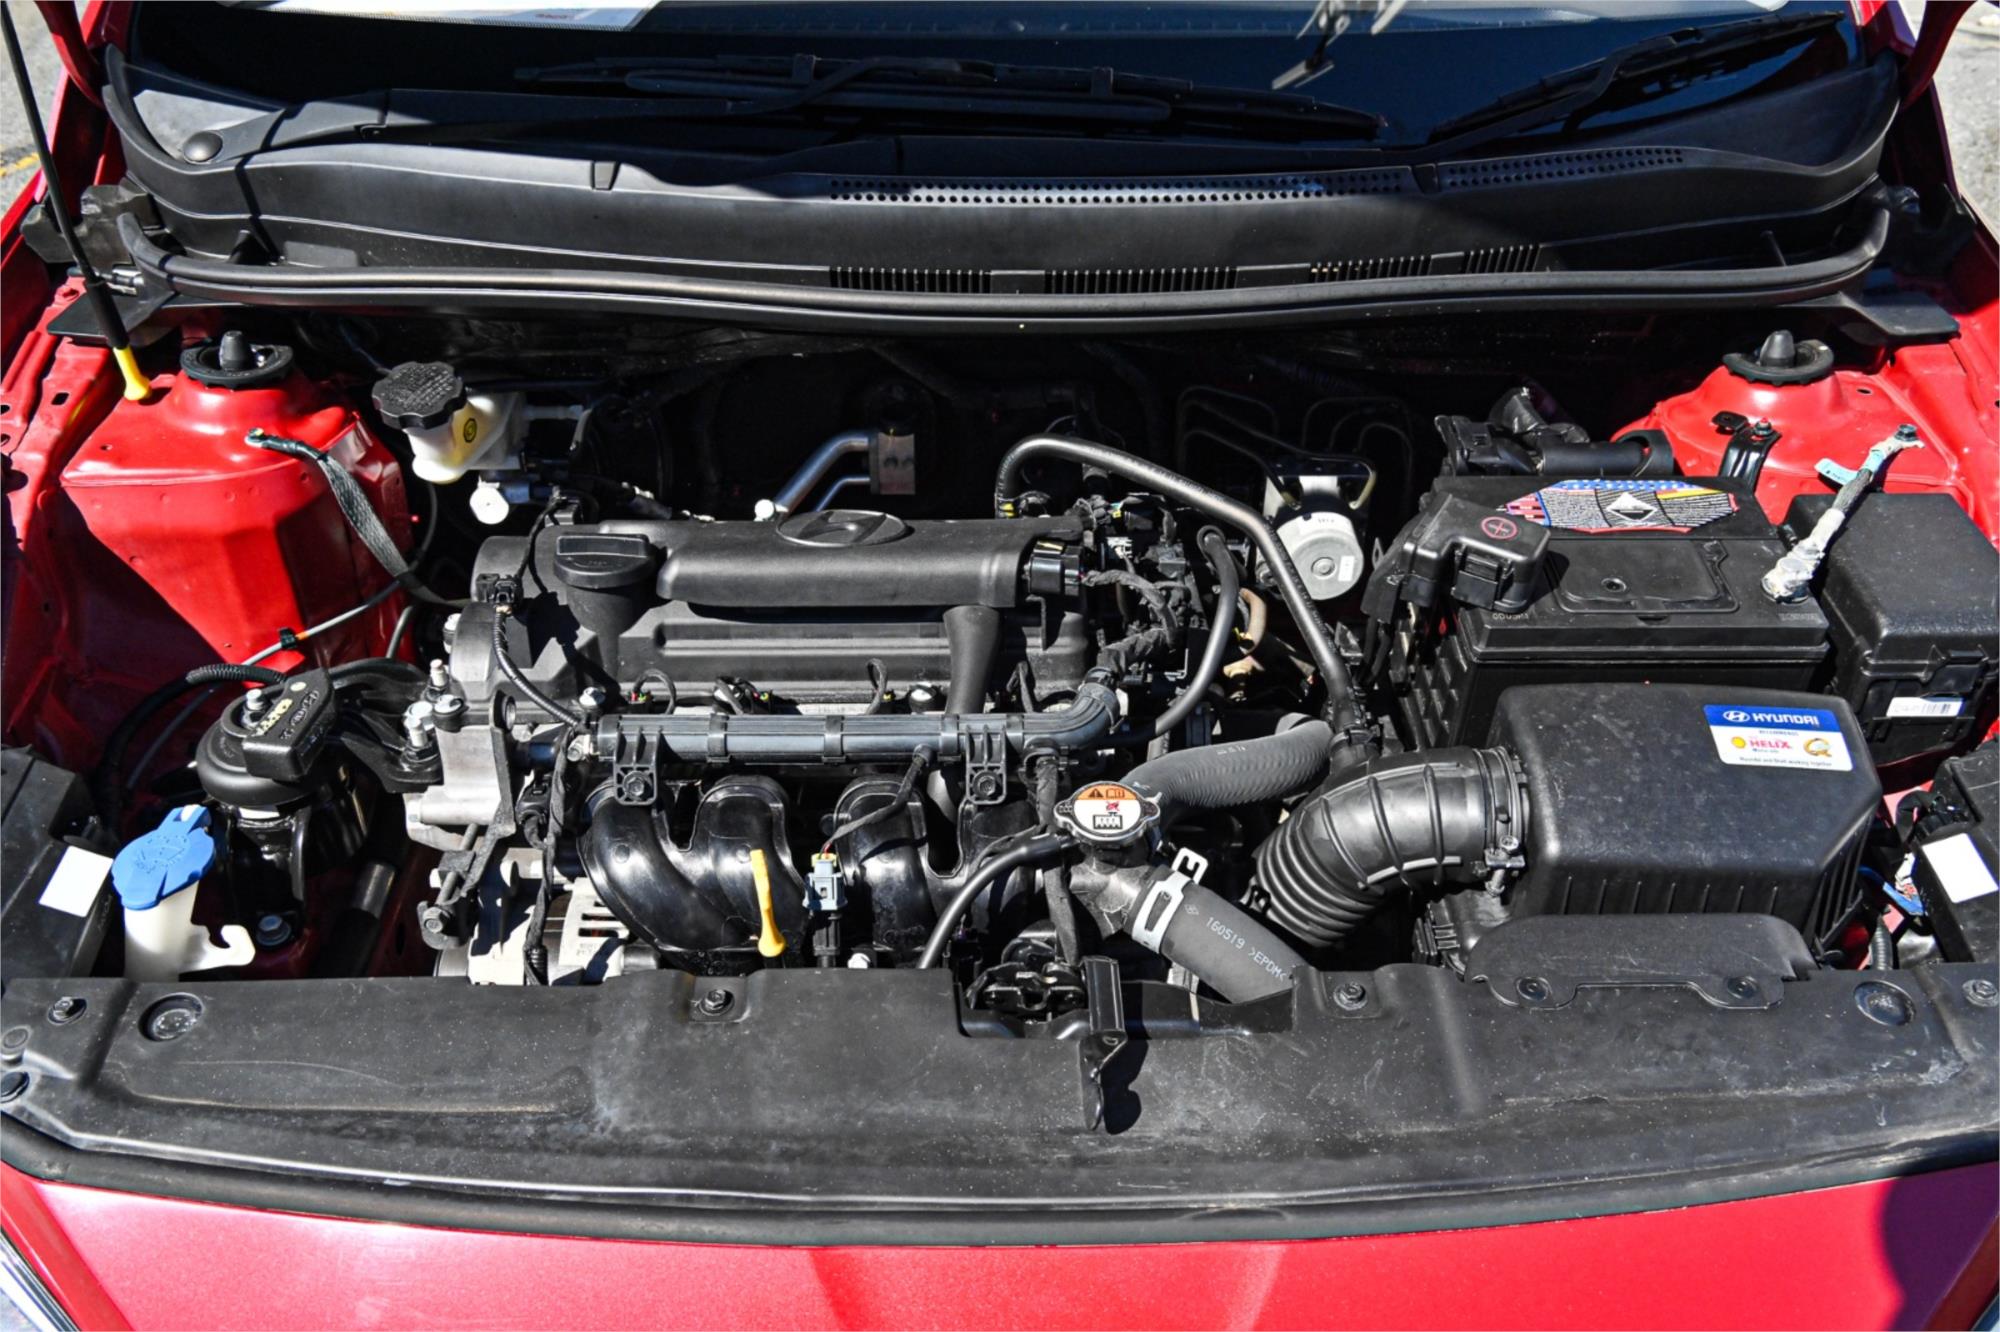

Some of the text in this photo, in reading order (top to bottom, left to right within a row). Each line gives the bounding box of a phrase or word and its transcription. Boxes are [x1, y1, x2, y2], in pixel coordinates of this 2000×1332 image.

[1752, 713, 1820, 725] HYUNDAI
[1750, 739, 1792, 749] HELIX
[1206, 917, 1246, 949] 160519
